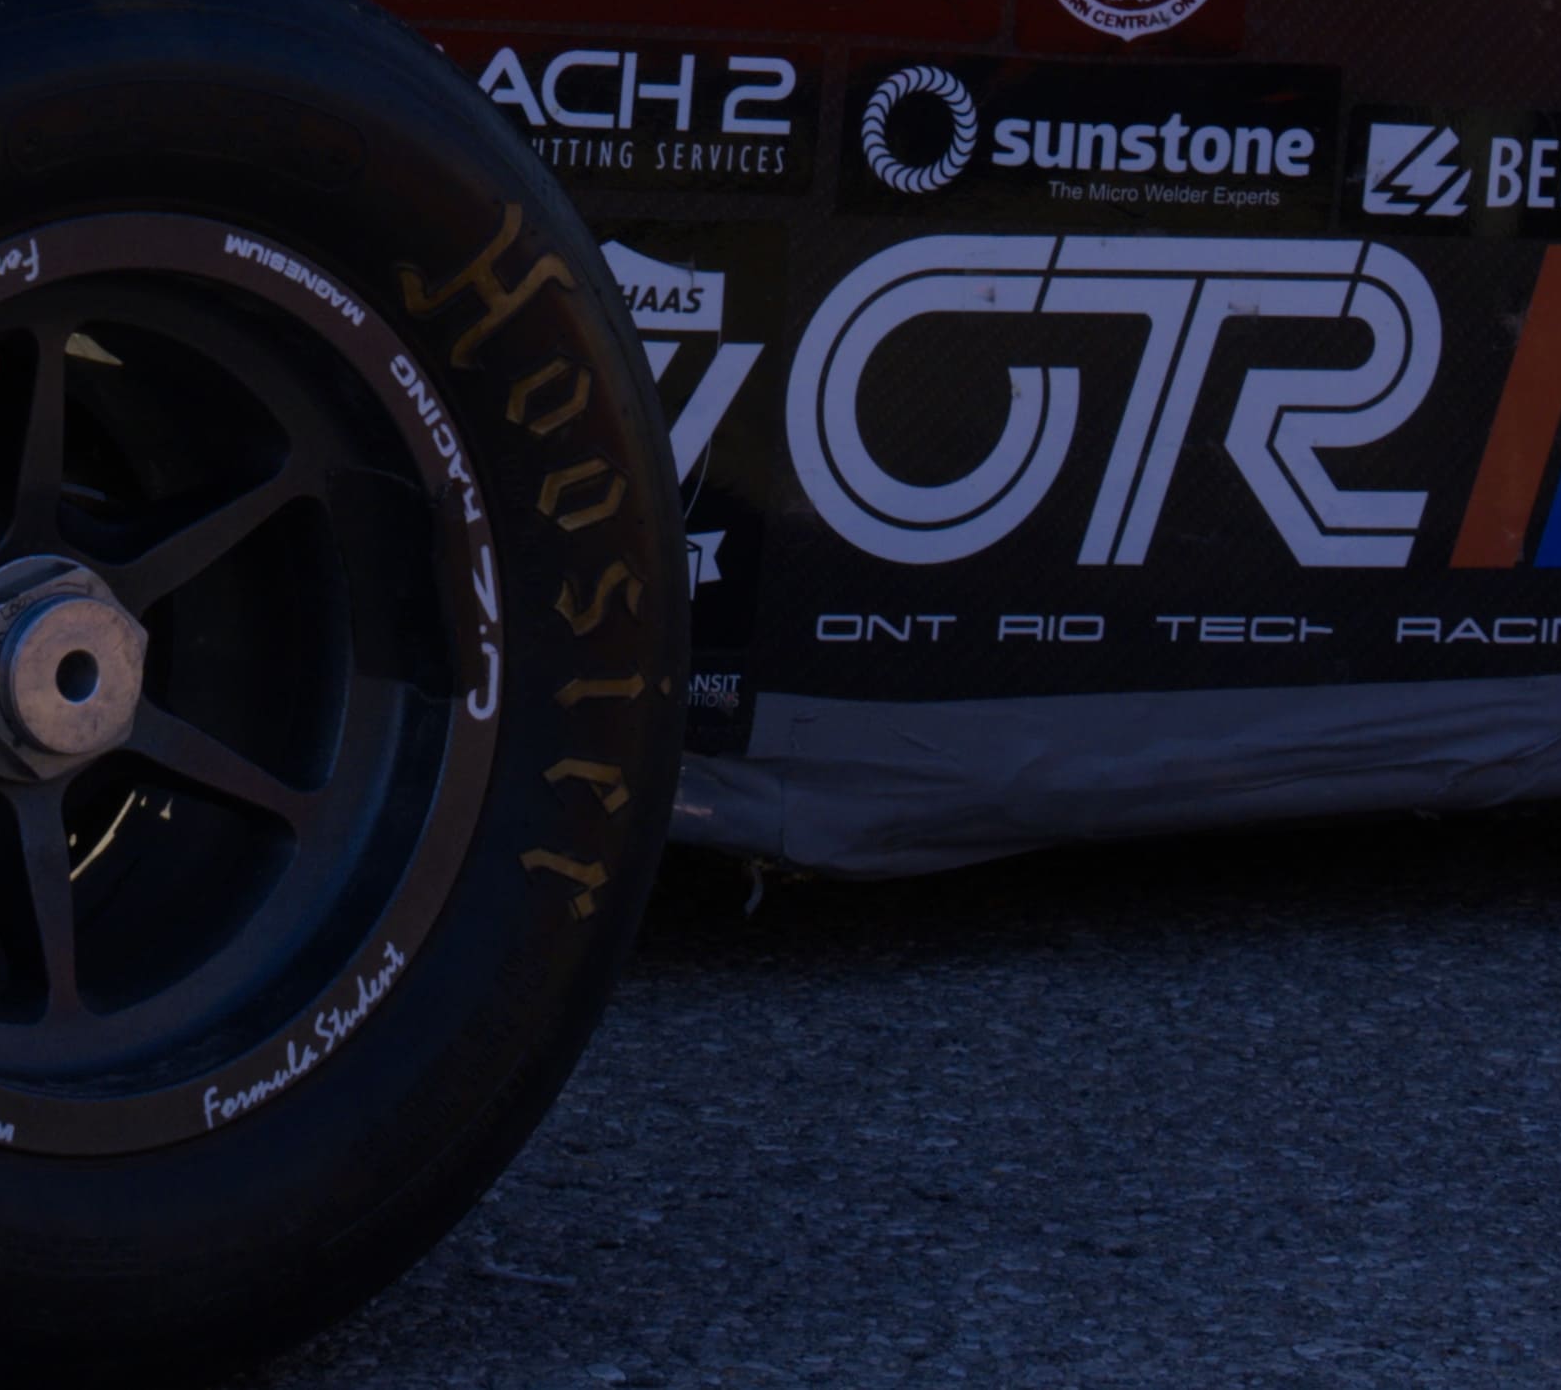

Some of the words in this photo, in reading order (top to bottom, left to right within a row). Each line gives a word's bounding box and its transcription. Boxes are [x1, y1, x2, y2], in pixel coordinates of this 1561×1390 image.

[1092, 9, 1173, 30] CENTRAL
[477, 46, 696, 132] ACH
[721, 55, 797, 135] 2
[655, 142, 787, 175] SERVICES
[991, 112, 1316, 178] sunstone
[1048, 180, 1083, 200] The
[1088, 182, 1140, 204] Micro
[1144, 183, 1208, 205] Welder
[1212, 186, 1281, 209] Experts
[223, 232, 367, 327] MAGNESIUM
[203, 1040, 319, 1129] Formula
[314, 940, 406, 1055] Student
